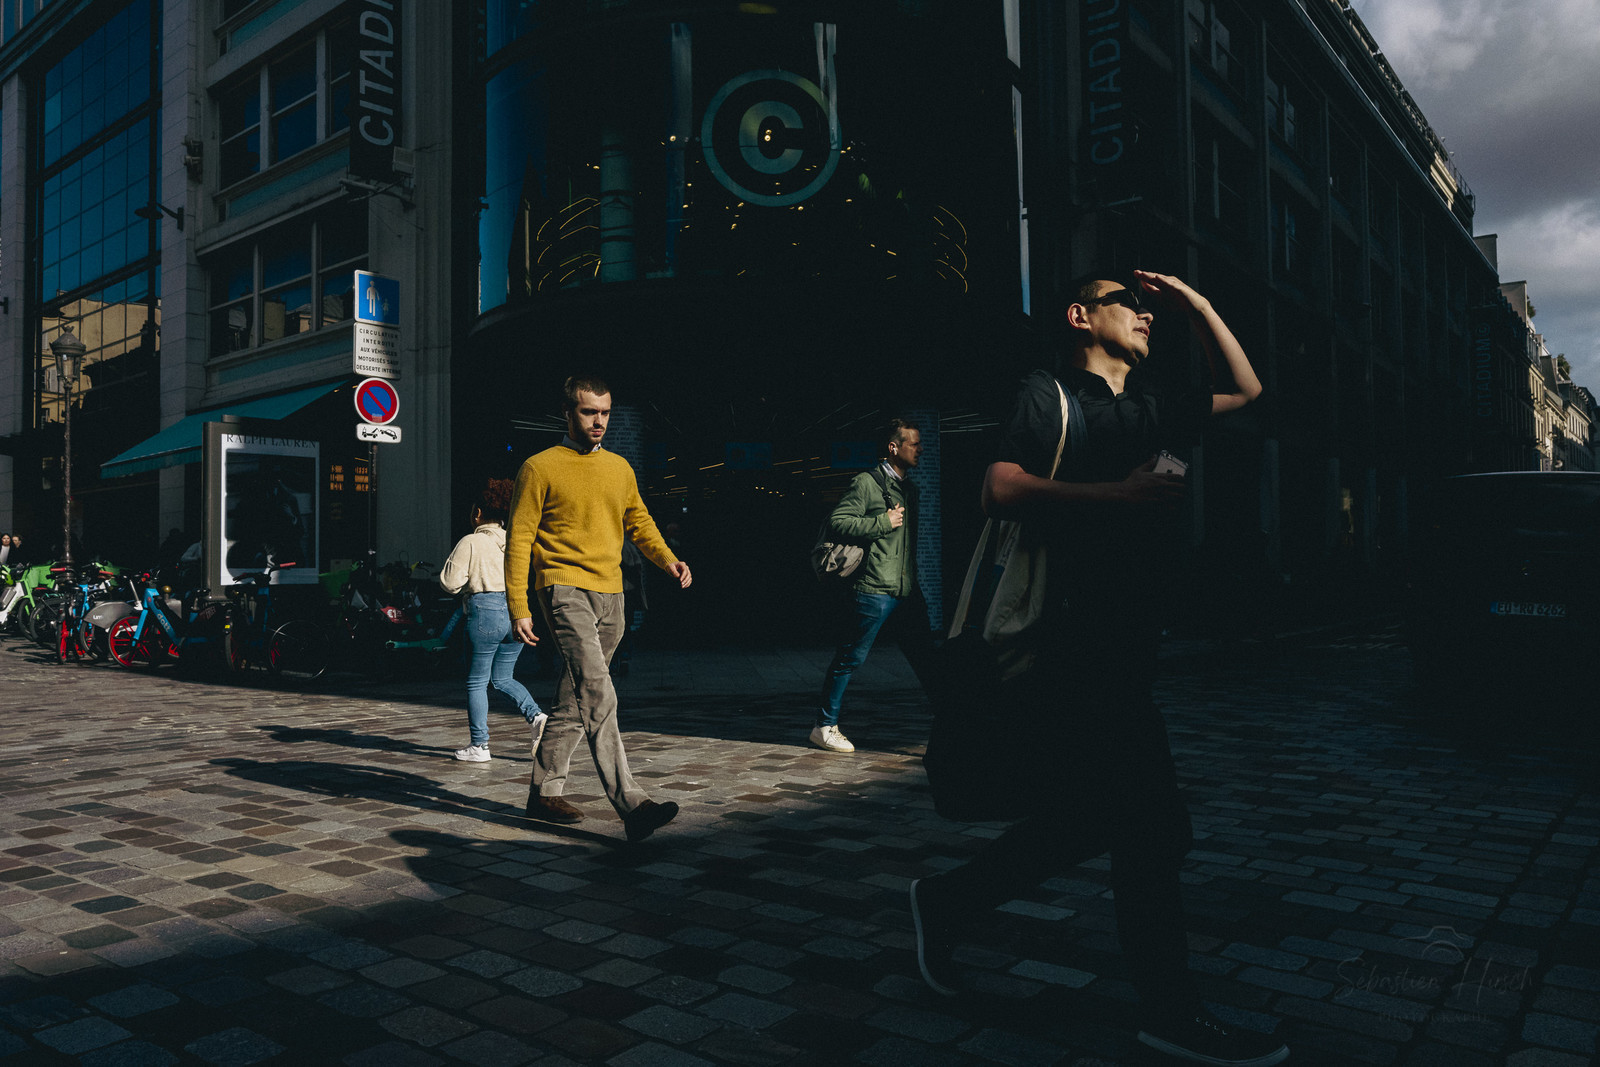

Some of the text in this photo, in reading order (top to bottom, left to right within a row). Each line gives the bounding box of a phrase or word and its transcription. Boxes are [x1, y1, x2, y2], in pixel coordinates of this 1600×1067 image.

[359, 328, 398, 339] CIRCULATION
[363, 338, 394, 348] INTERDITE
[371, 347, 397, 357] VÉHICULES
[358, 355, 386, 364] MOTORISÉS
[356, 364, 381, 372] DESSERTE
[226, 434, 317, 449] RALPH LAUREN
[156, 613, 171, 632] dott
